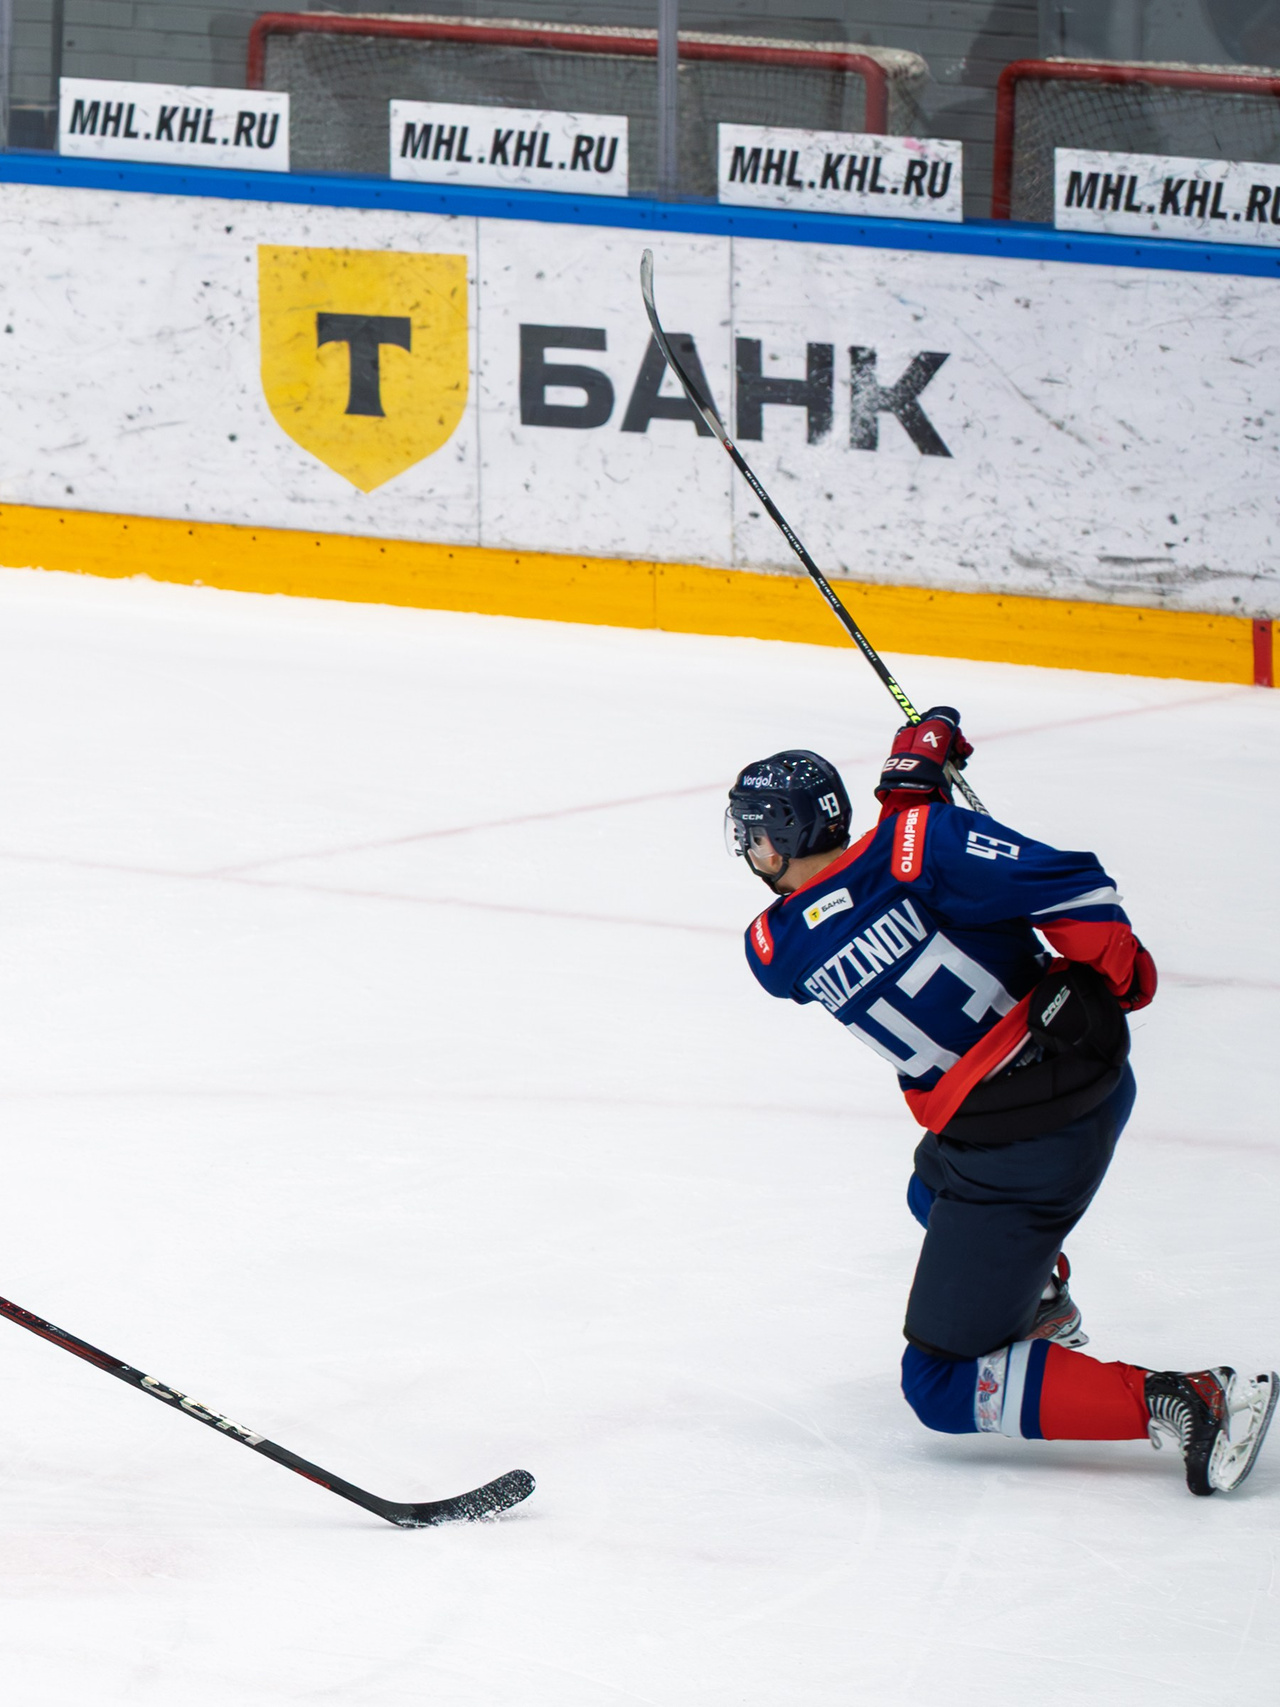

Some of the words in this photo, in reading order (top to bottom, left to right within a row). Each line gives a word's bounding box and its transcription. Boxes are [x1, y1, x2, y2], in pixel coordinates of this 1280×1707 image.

[69, 99, 279, 149] MHL.KHL.RU
[400, 122, 619, 174] MHL.KHL.RU
[728, 146, 953, 200] MHL.KHL.RU
[316, 312, 411, 417] Т
[520, 323, 953, 458] БАНК
[818, 792, 840, 818] 43
[966, 831, 1020, 860] 43
[804, 898, 928, 1013] SOZINOV
[844, 931, 1021, 1078] 43
